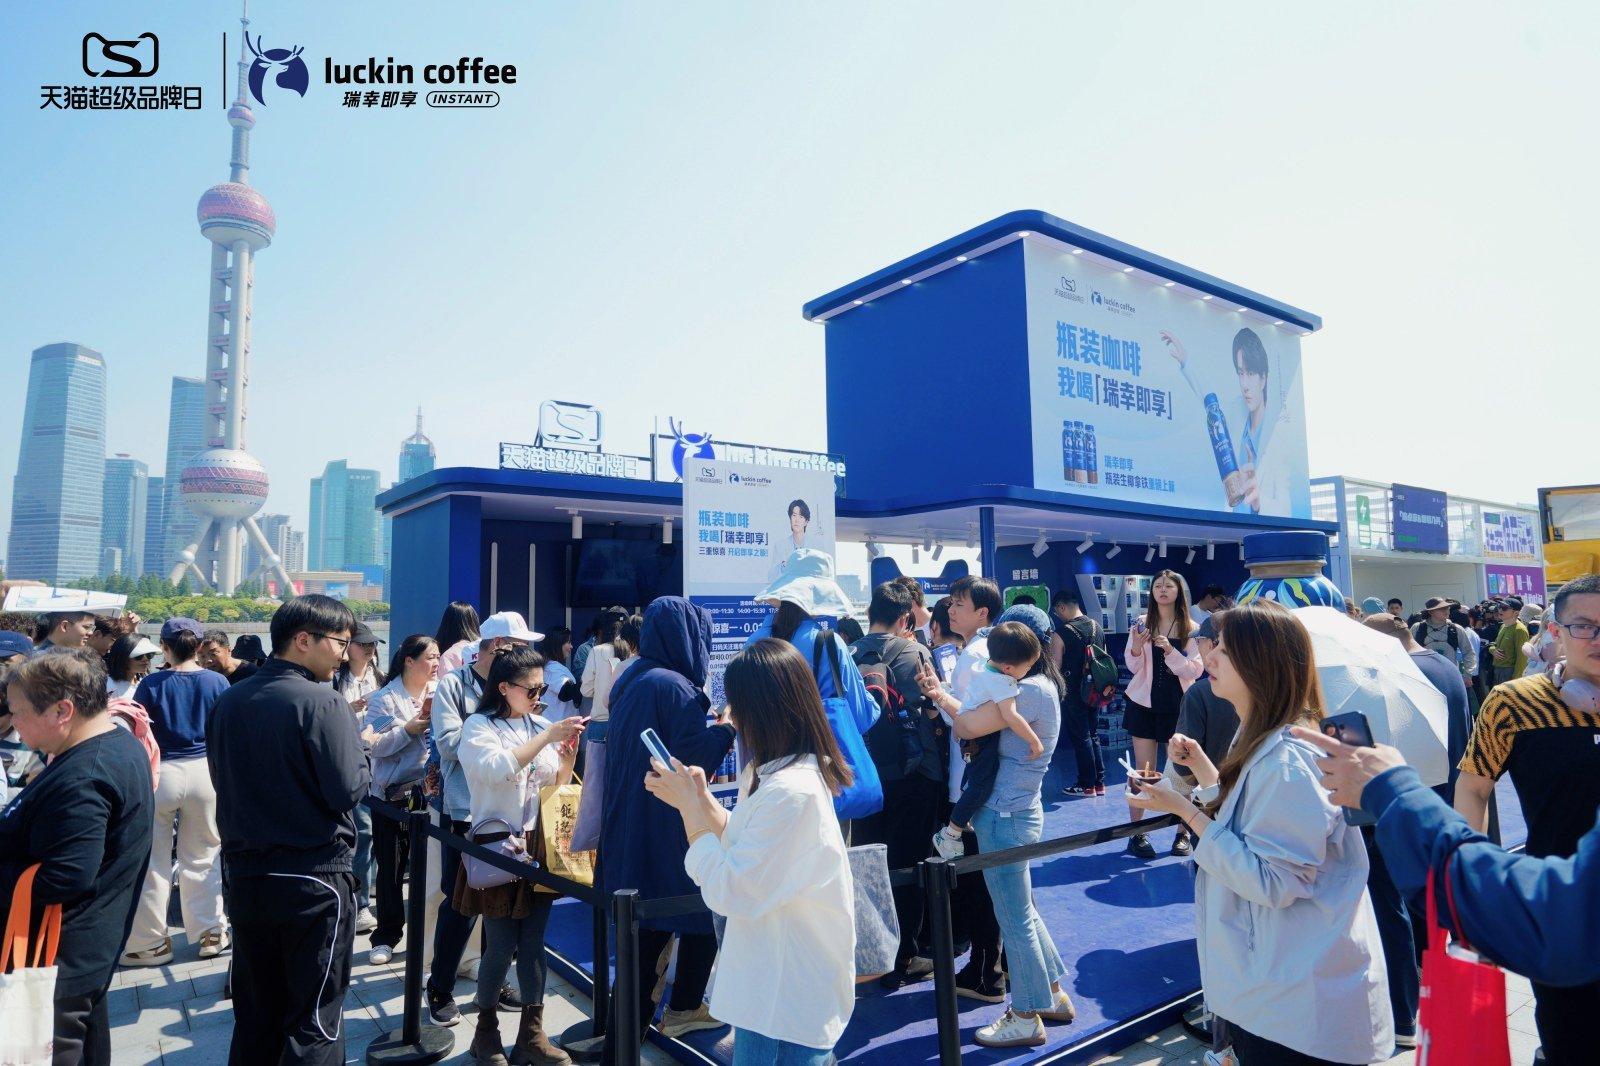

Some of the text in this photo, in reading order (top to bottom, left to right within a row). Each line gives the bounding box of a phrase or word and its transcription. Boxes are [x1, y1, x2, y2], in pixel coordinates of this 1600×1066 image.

[1056, 320, 1142, 377] 瓶装咖啡
[1057, 367, 1173, 420] 我喝「瑞幸即享」
[502, 446, 639, 478] 天猫超级品牌日
[698, 510, 750, 528] 瓶装咖啡
[698, 529, 769, 546] 我喝「瑞幸即享」
[699, 546, 726, 556] 三重惊喜
